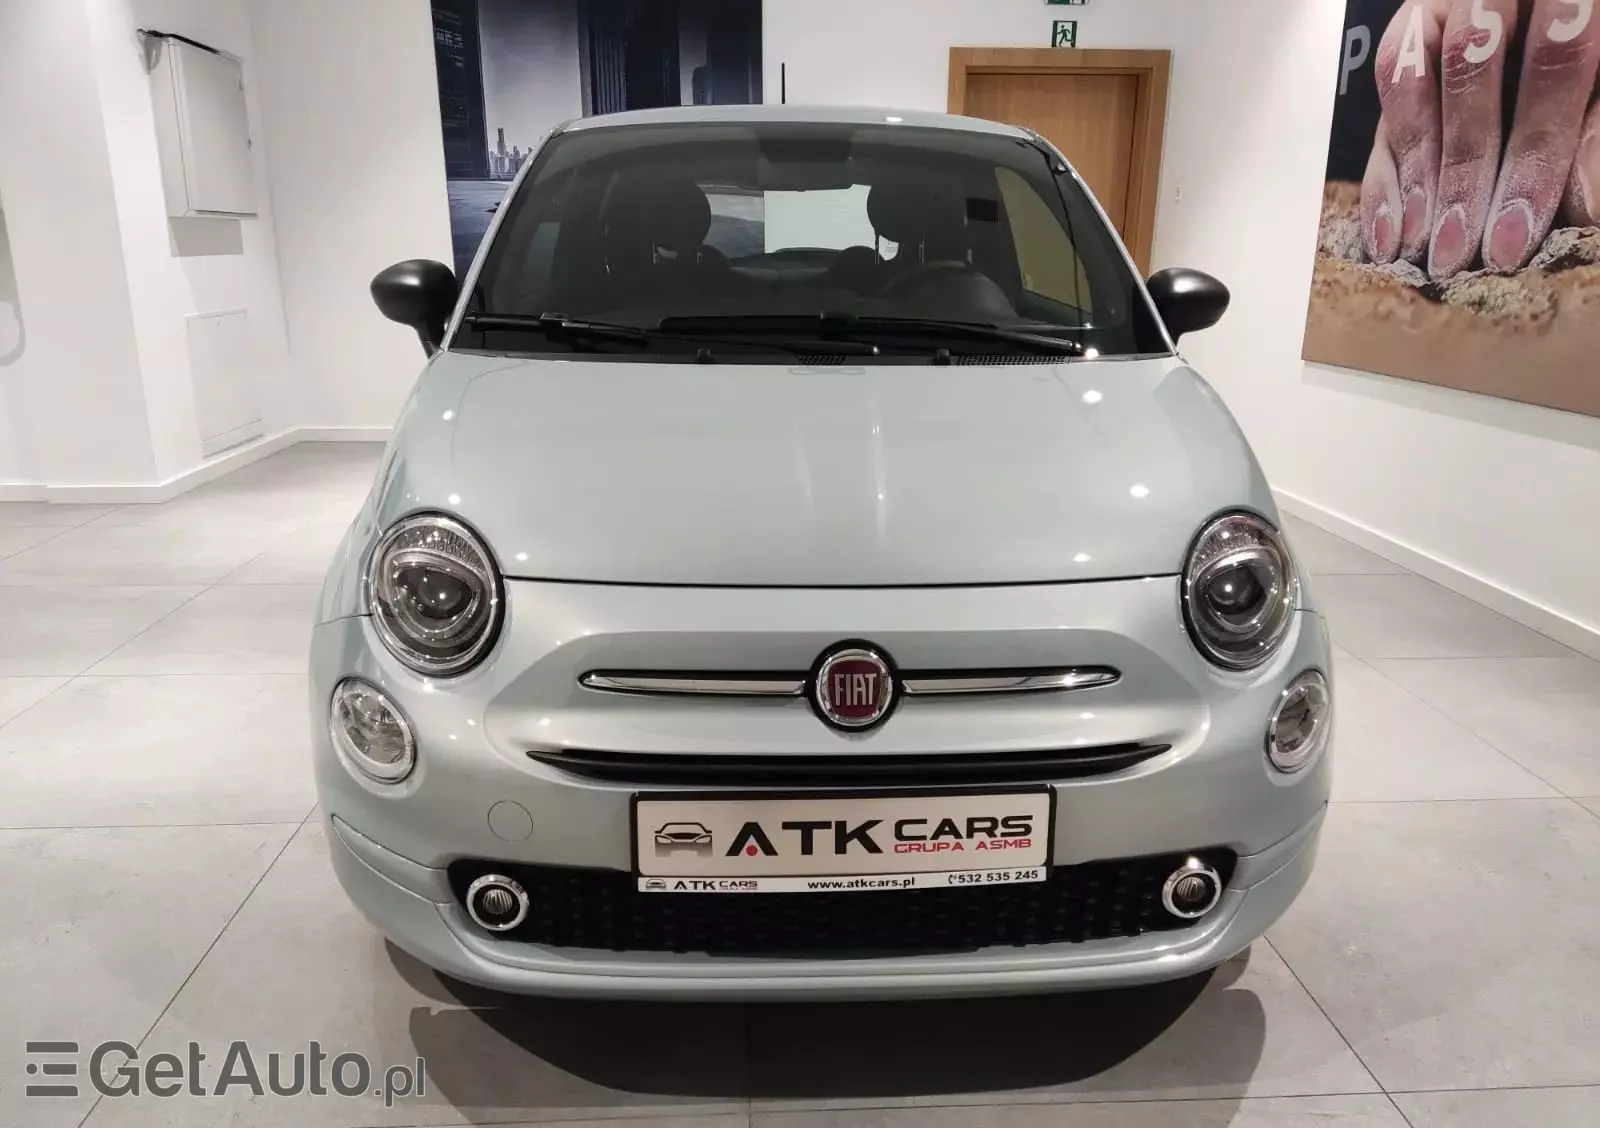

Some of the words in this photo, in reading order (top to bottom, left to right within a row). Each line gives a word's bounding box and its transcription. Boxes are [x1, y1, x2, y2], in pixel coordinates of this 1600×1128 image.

[834, 673, 877, 706] FIAT
[725, 819, 884, 857] ATK
[894, 815, 1034, 842] CARS
[894, 842, 965, 854] GRUPA
[975, 838, 1032, 850] ASMB
[807, 877, 915, 889] www.atkcars.pl
[958, 873, 982, 883] 532
[986, 872, 1010, 882] 535
[1014, 870, 1038, 880] 245
[673, 880, 716, 890] ATK
[719, 880, 758, 888] CARS
